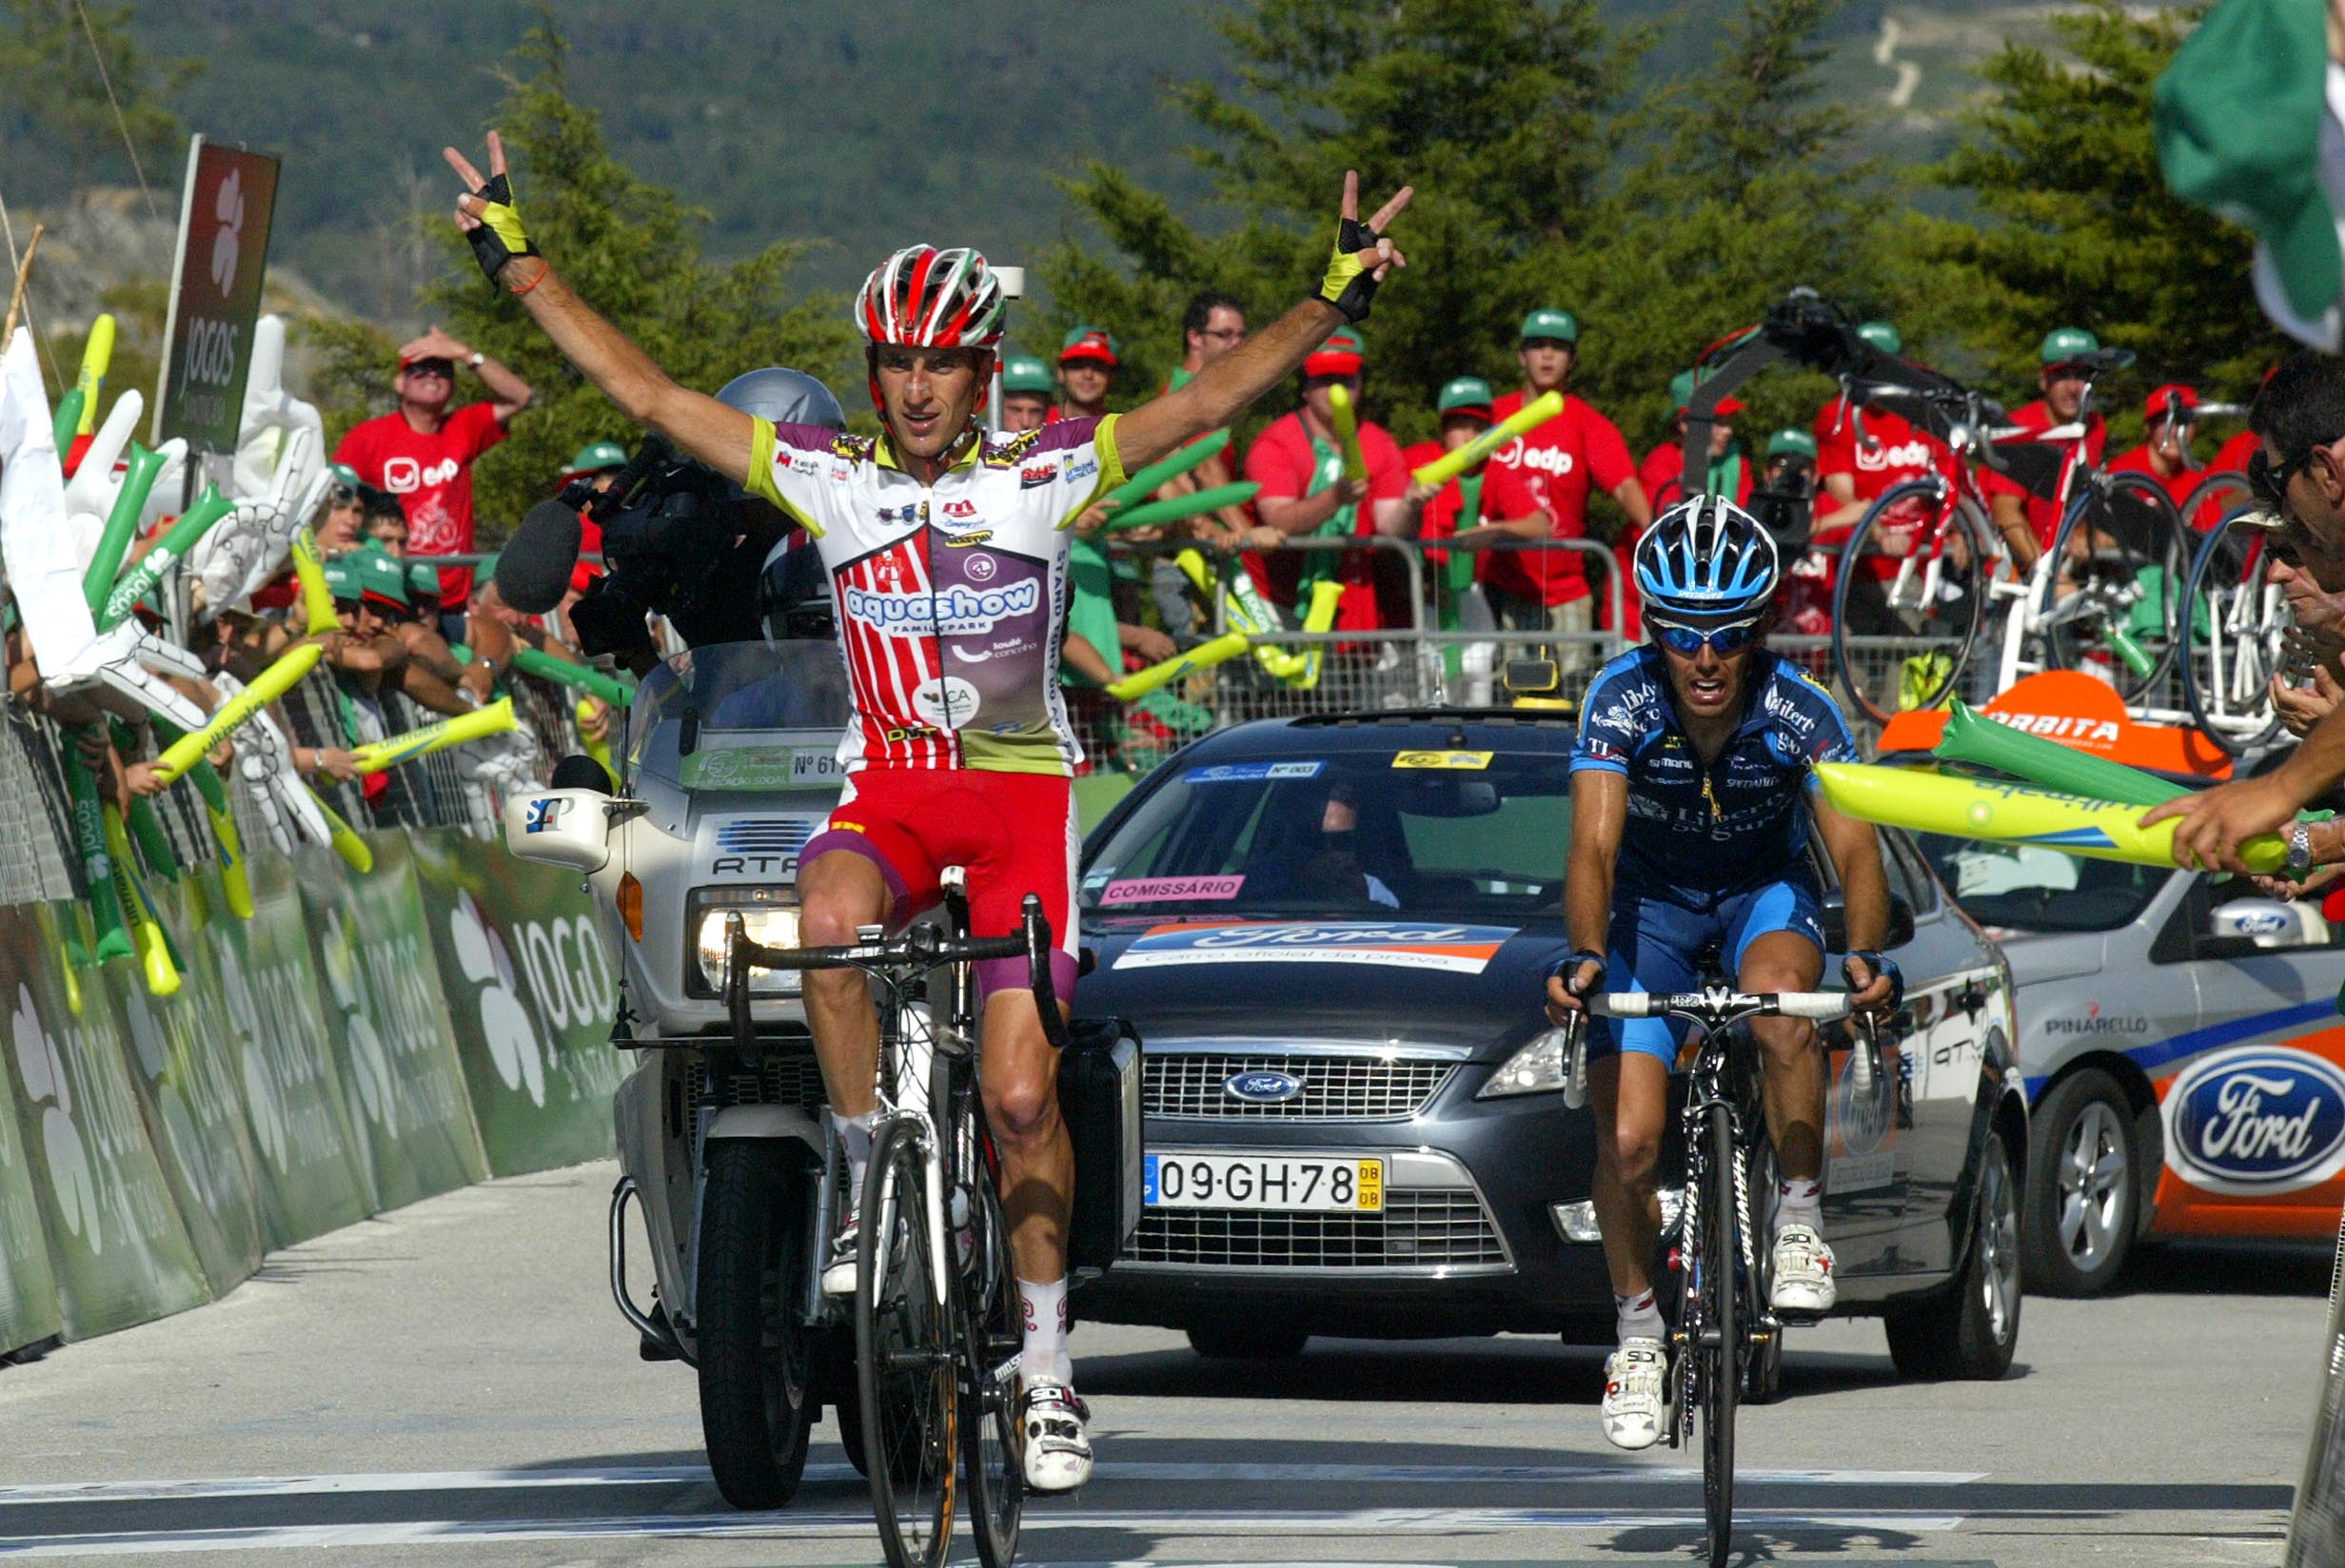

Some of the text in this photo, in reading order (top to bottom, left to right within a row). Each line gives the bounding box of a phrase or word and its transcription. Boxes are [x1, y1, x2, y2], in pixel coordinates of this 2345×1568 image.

[1523, 445, 1573, 478] edp
[108, 568, 152, 617] JOGOS
[1053, 550, 1067, 618] STAND
[847, 583, 1035, 628] aquashow
[893, 621, 987, 634] FAMILY PARK
[1109, 880, 1235, 899] COMISSÁRIO
[2241, 916, 2278, 931] Ford
[1192, 924, 1468, 949] Ford
[1146, 952, 1226, 962] Carro
[1322, 951, 1357, 959] da
[1365, 952, 1449, 966] prova
[2046, 1017, 2147, 1035] PINARELLO
[1243, 1077, 1282, 1093] Ford
[2201, 1073, 2322, 1160] Ford
[1360, 1166, 1379, 1180] 08
[1360, 1191, 1379, 1205] 08
